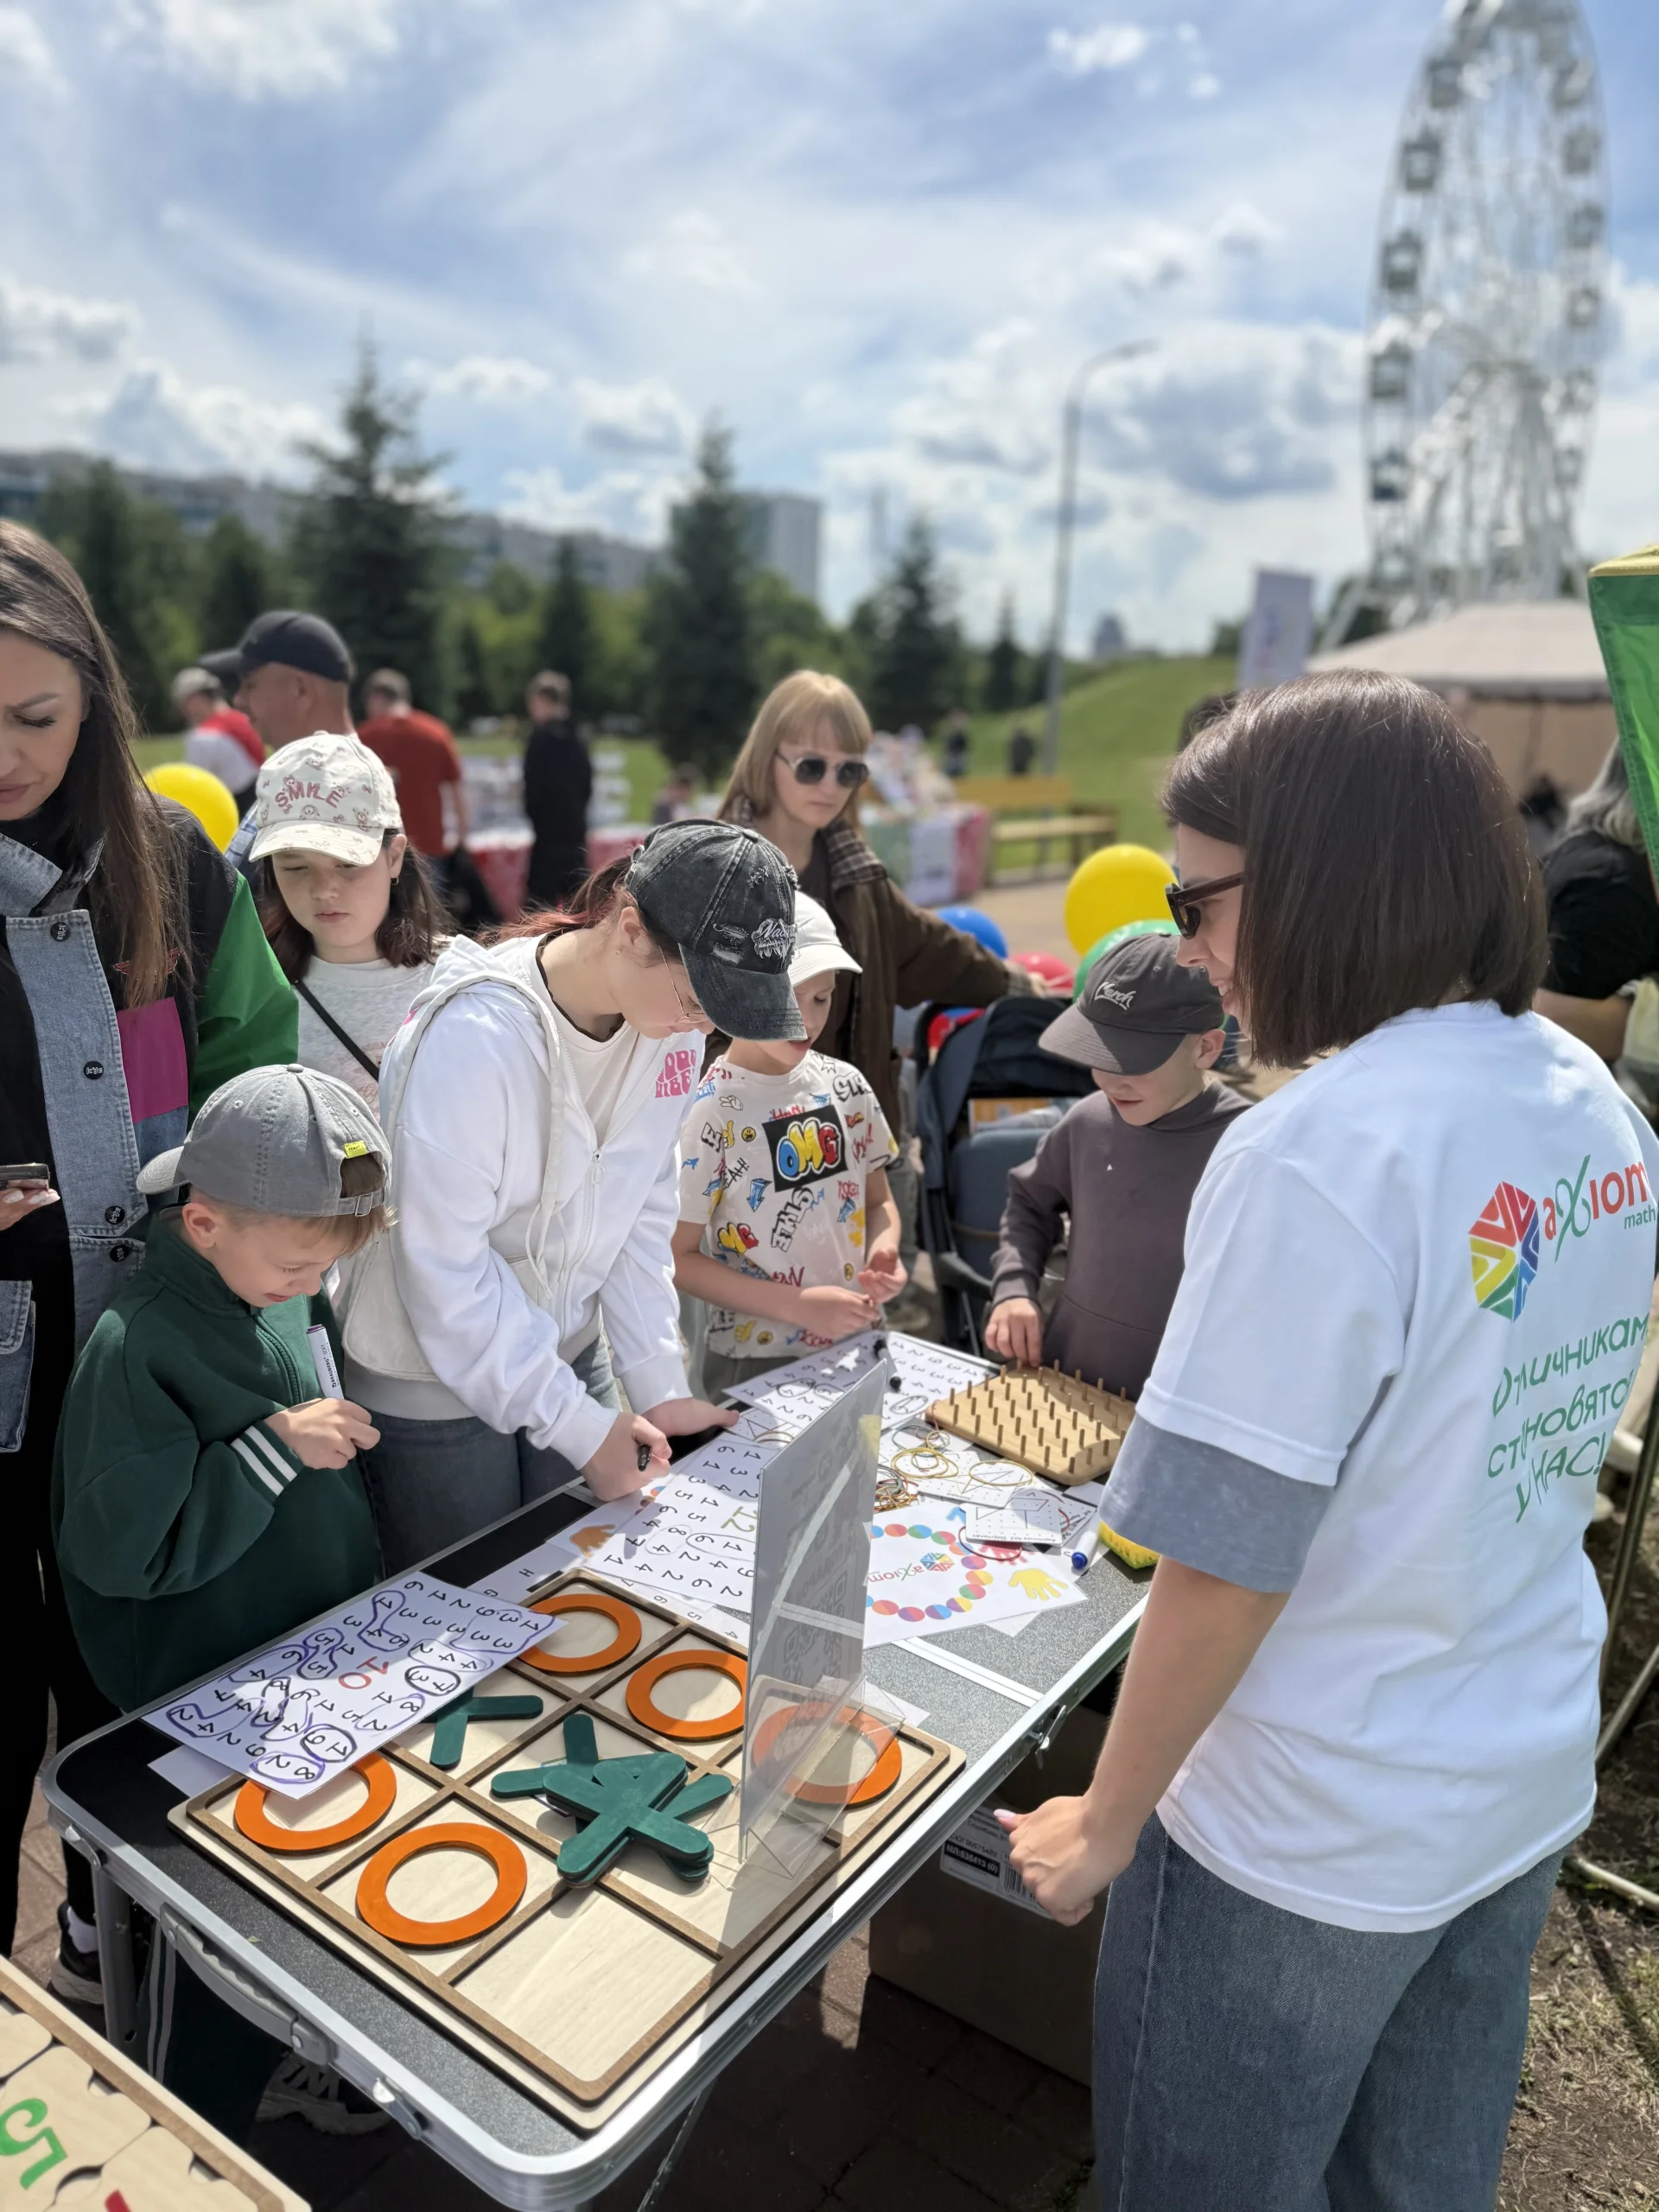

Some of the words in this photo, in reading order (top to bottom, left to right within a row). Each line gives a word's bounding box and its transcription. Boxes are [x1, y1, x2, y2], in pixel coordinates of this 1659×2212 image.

[275, 782, 344, 808] SMILE
[777, 1116, 842, 1179] OMG
[744, 1452, 761, 1460] 1
[702, 1460, 721, 1470] 1
[675, 1490, 694, 1500] 5
[739, 1490, 759, 1498] 2
[701, 1497, 719, 1507] 1
[688, 1513, 707, 1522] 5
[626, 1537, 645, 1547] 7
[723, 1541, 742, 1552] 1
[604, 1554, 623, 1565] 1
[679, 1551, 700, 1560] 2
[634, 1563, 653, 1572] 4
[709, 1560, 728, 1569] 4
[662, 1570, 683, 1580] 2
[429, 1590, 447, 1600] 1
[721, 1586, 742, 1597] 2
[374, 1597, 392, 1609] 1
[449, 1599, 471, 1609] 2
[399, 1608, 418, 1618] 3
[499, 1613, 518, 1623] 3
[343, 1616, 362, 1626] 3
[423, 1617, 442, 1626] 3
[519, 1620, 539, 1630] 1
[366, 1629, 383, 1637] 4
[447, 1623, 466, 1633] 3
[315, 1633, 335, 1645] 5
[471, 1630, 490, 1640] 3
[414, 1643, 433, 1653] 2
[493, 1638, 512, 1649] 3
[336, 1643, 354, 1655] 1
[438, 1653, 455, 1662] 4
[308, 1661, 328, 1674] 5
[461, 1661, 477, 1669] 4
[250, 1669, 266, 1679] 4
[410, 1671, 429, 1681] 3
[270, 1680, 289, 1690] 8
[433, 1681, 454, 1693] 7
[214, 1689, 236, 1701] 7
[372, 1692, 392, 1704] 1
[236, 1700, 251, 1711] 4
[314, 1700, 334, 1712] 1
[400, 1702, 420, 1712] 8
[169, 1708, 194, 1720] 2
[259, 1711, 278, 1722] 2
[342, 1710, 364, 1722] 5
[197, 1722, 213, 1732] 4
[282, 1723, 298, 1732] 4
[363, 1719, 387, 1731] 2
[217, 1732, 241, 1745] 2
[326, 1742, 347, 1756] 1
[265, 1754, 290, 1768] 2
[294, 1767, 315, 1780] 8
